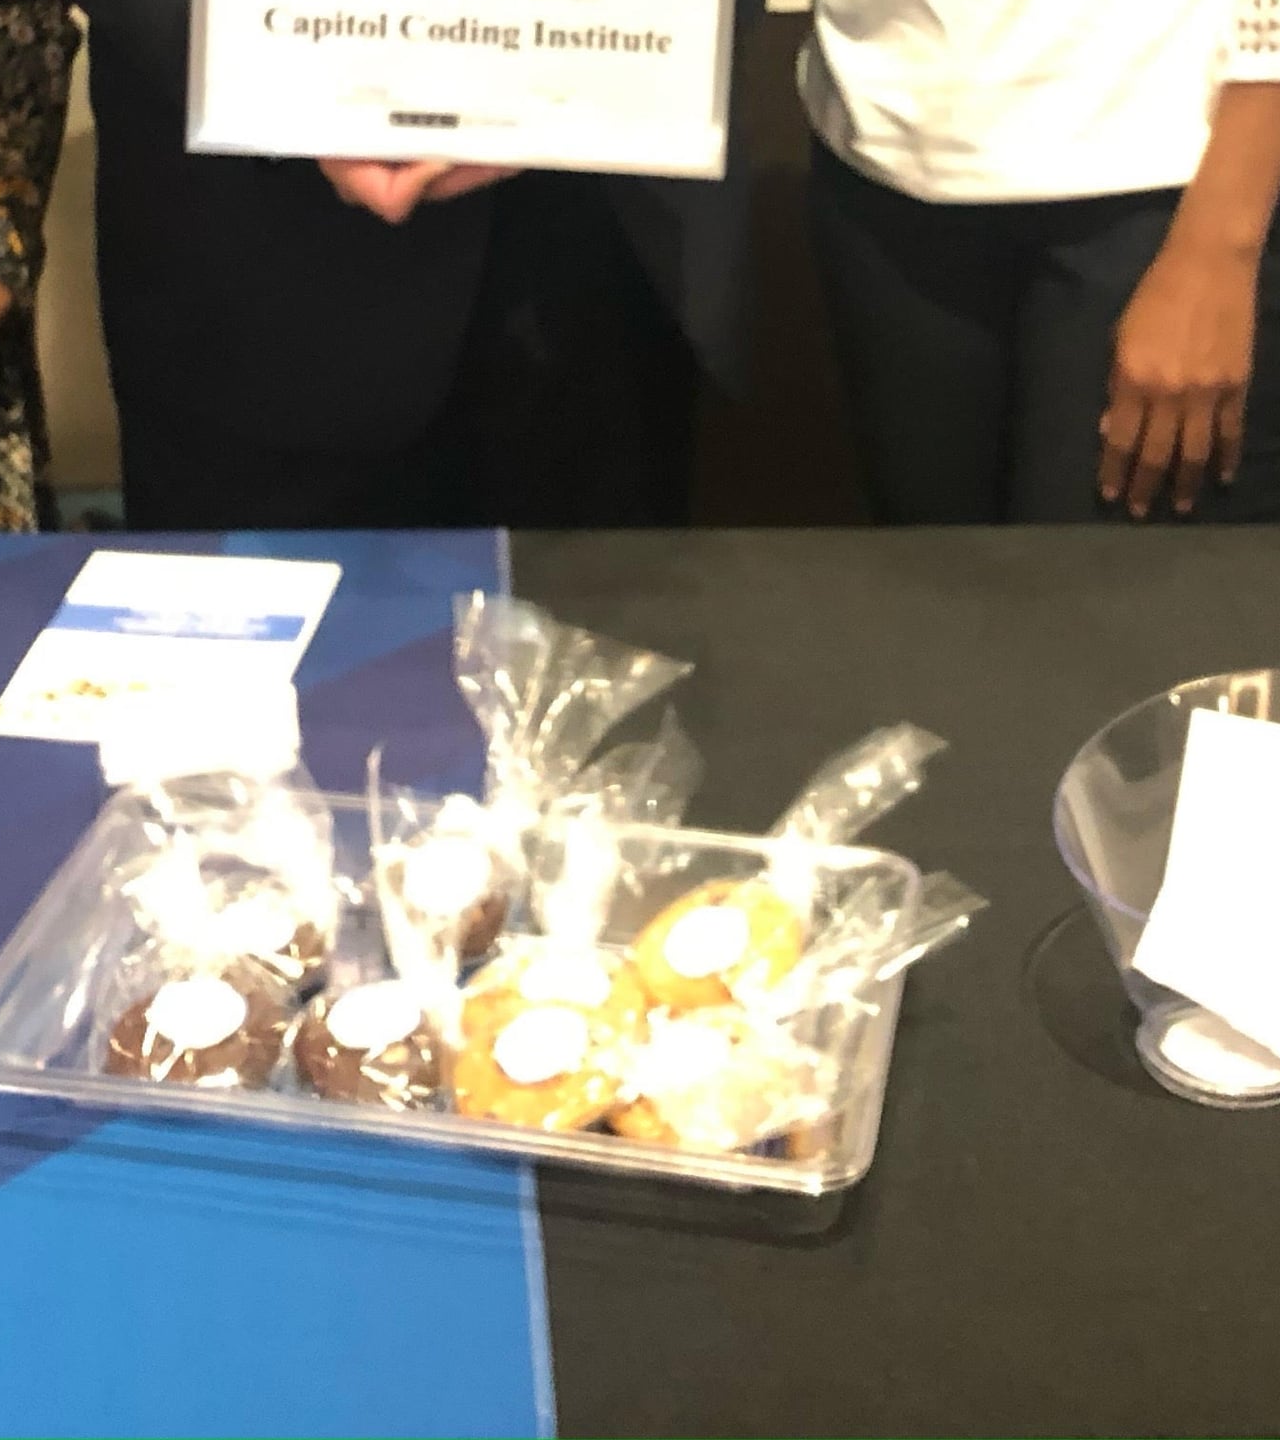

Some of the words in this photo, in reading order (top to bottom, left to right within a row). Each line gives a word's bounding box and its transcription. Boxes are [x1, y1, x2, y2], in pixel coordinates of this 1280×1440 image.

[263, 7, 388, 43] Capitol
[398, 14, 521, 52] Coding
[533, 19, 673, 55] Institute
